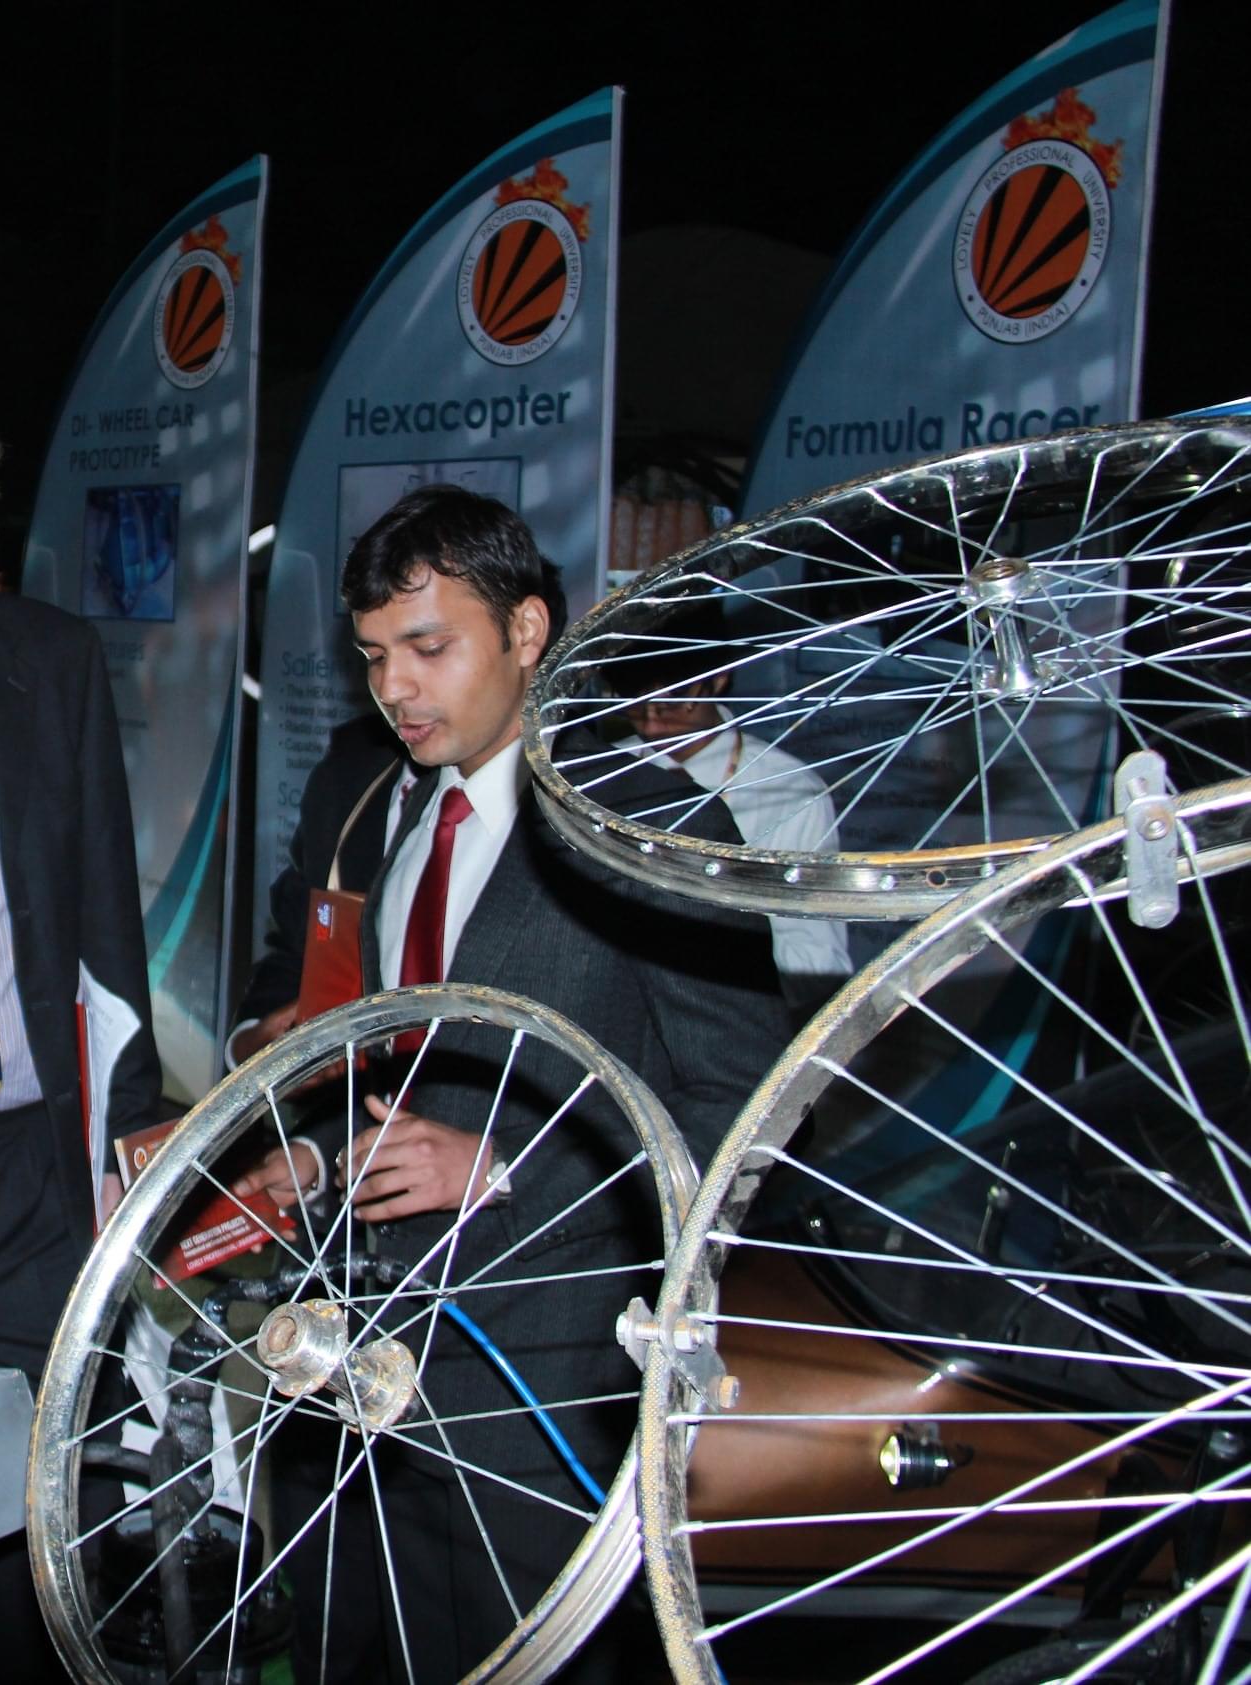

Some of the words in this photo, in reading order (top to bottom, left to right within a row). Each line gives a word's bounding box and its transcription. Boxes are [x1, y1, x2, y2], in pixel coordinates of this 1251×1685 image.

[956, 208, 977, 270] LOVELY
[984, 145, 1075, 192] PROFESSIONAL
[1082, 169, 1107, 261] UNIVERSITY
[459, 255, 476, 305] LOVELY
[480, 204, 554, 240] PROFESSIONAL
[558, 227, 581, 301] UNIVERSITY
[976, 306, 1022, 336] PUNJAB
[97, 407, 151, 432] WHEEL
[155, 402, 195, 429] CAR
[344, 384, 571, 438] Hexacopter
[785, 406, 945, 458] Formula
[960, 402, 1102, 449] Racer
[69, 444, 161, 472] PROTOTYPE
